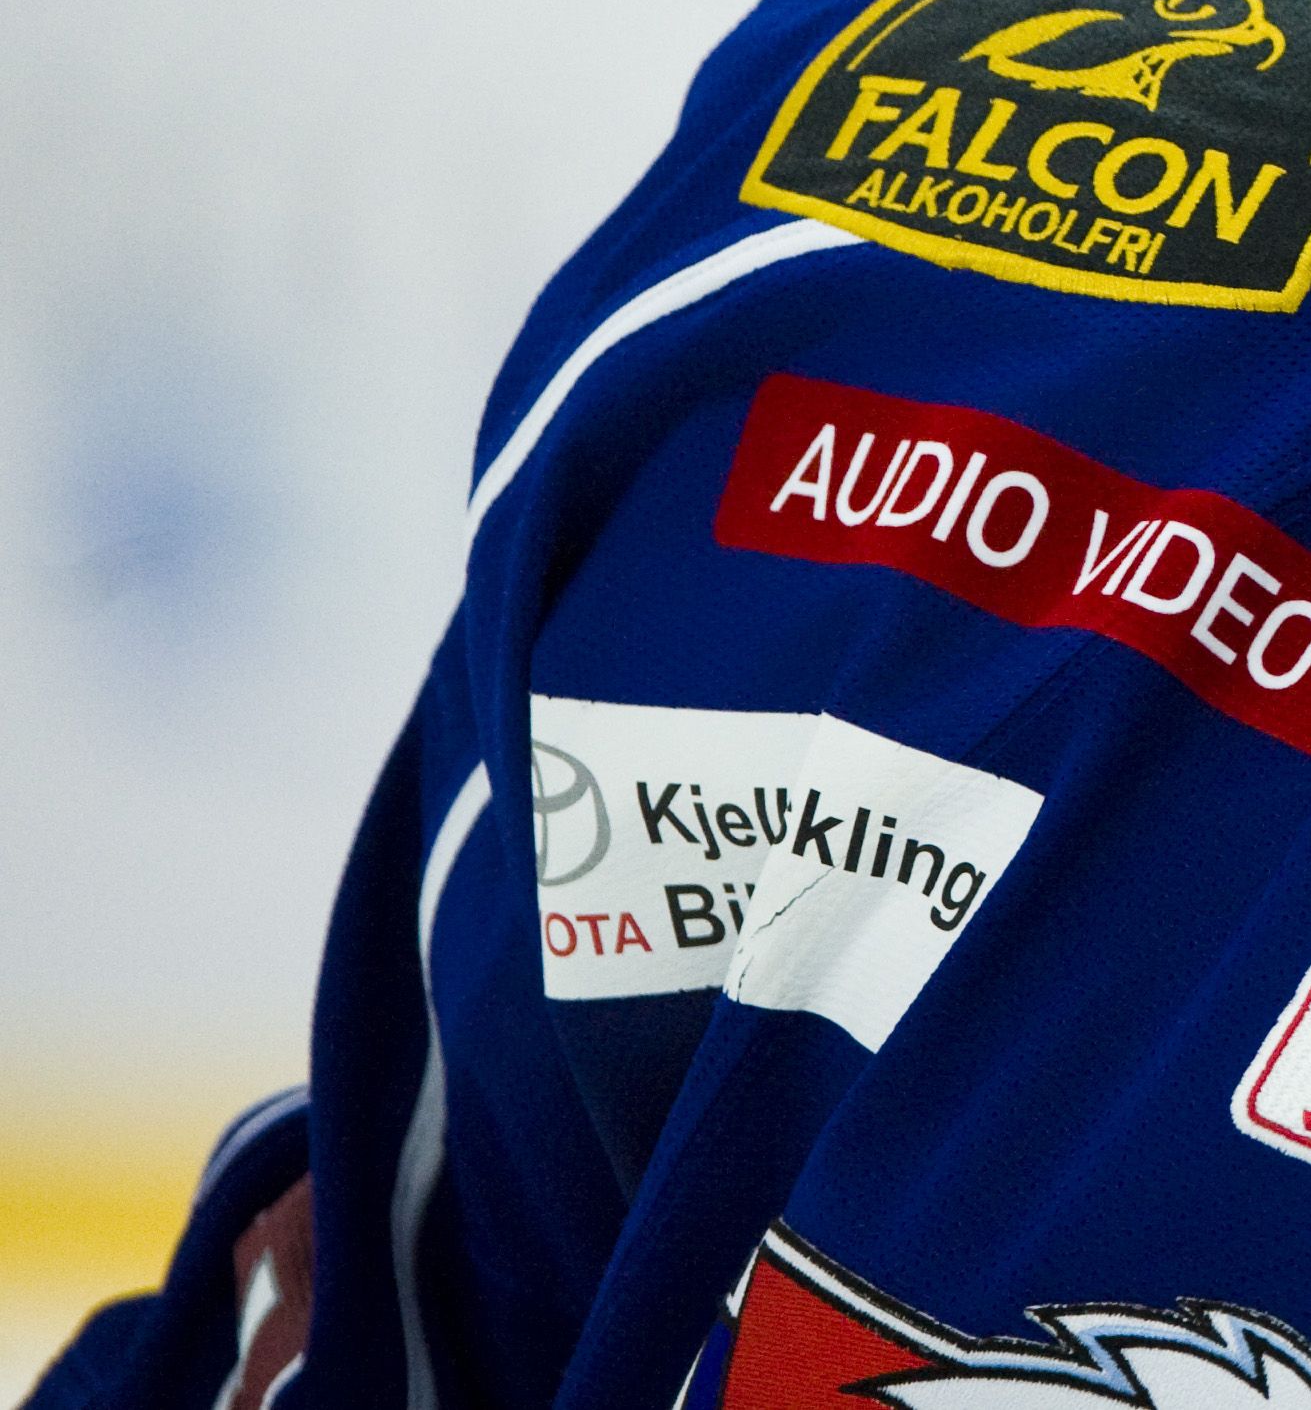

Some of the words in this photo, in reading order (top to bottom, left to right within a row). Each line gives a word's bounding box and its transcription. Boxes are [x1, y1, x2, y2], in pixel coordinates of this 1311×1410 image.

[824, 75, 1287, 245] FALCON
[845, 167, 1167, 275] ALKOHOLFRI
[769, 422, 1050, 570] AUDIO
[783, 788, 987, 932] kling
[544, 911, 653, 957] OTA
